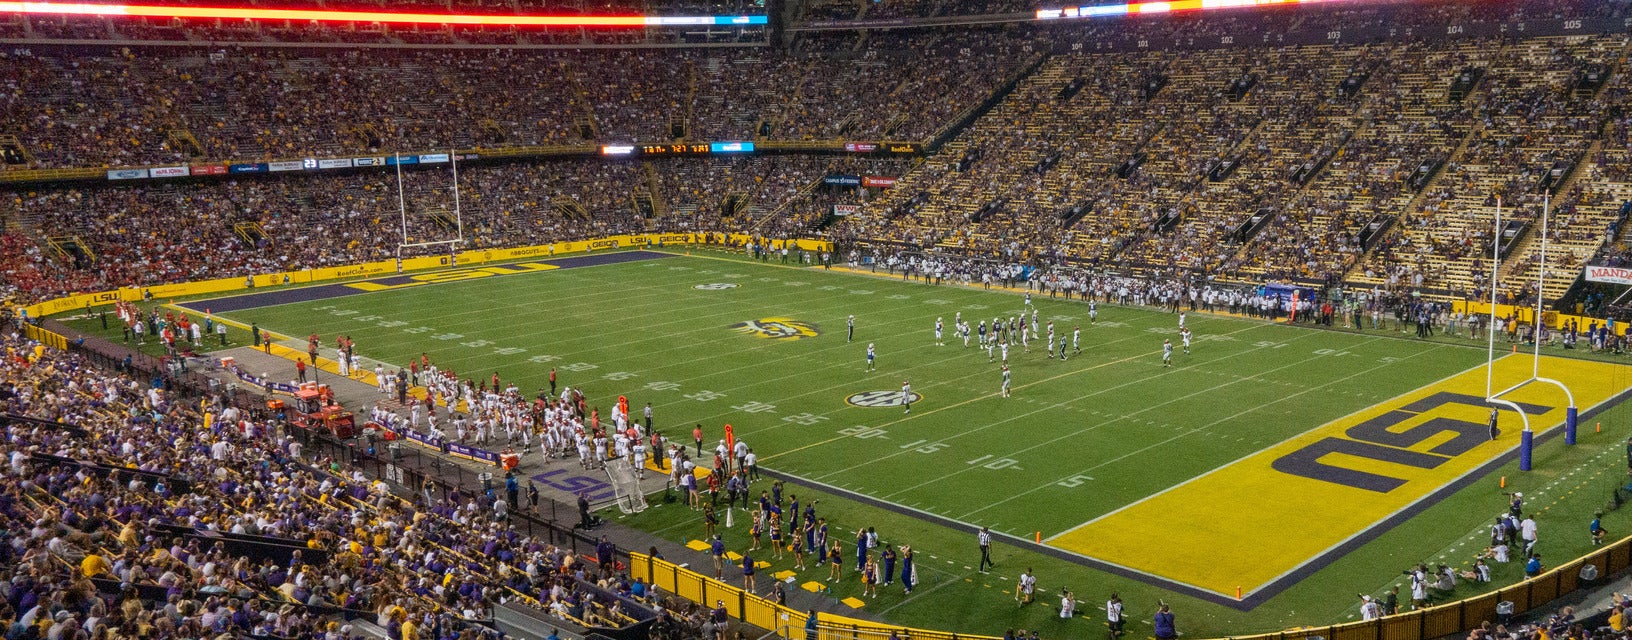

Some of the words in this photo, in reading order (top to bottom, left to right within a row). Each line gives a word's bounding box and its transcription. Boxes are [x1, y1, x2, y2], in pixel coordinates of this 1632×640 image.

[1447, 26, 1463, 34] 104
[1563, 20, 1582, 29] 105
[1327, 31, 1341, 39] 103
[1137, 40, 1149, 48] 101
[304, 159, 317, 168] 23
[630, 237, 647, 245] LSU
[659, 235, 688, 244] GEICO
[342, 263, 560, 292] LSU
[94, 291, 117, 303] LSU
[837, 425, 888, 439] 20
[900, 439, 951, 454] 15
[1271, 391, 1556, 494] LSU
[966, 454, 1020, 470] 10
[530, 468, 624, 500] LSU
[1057, 475, 1094, 488] 5
